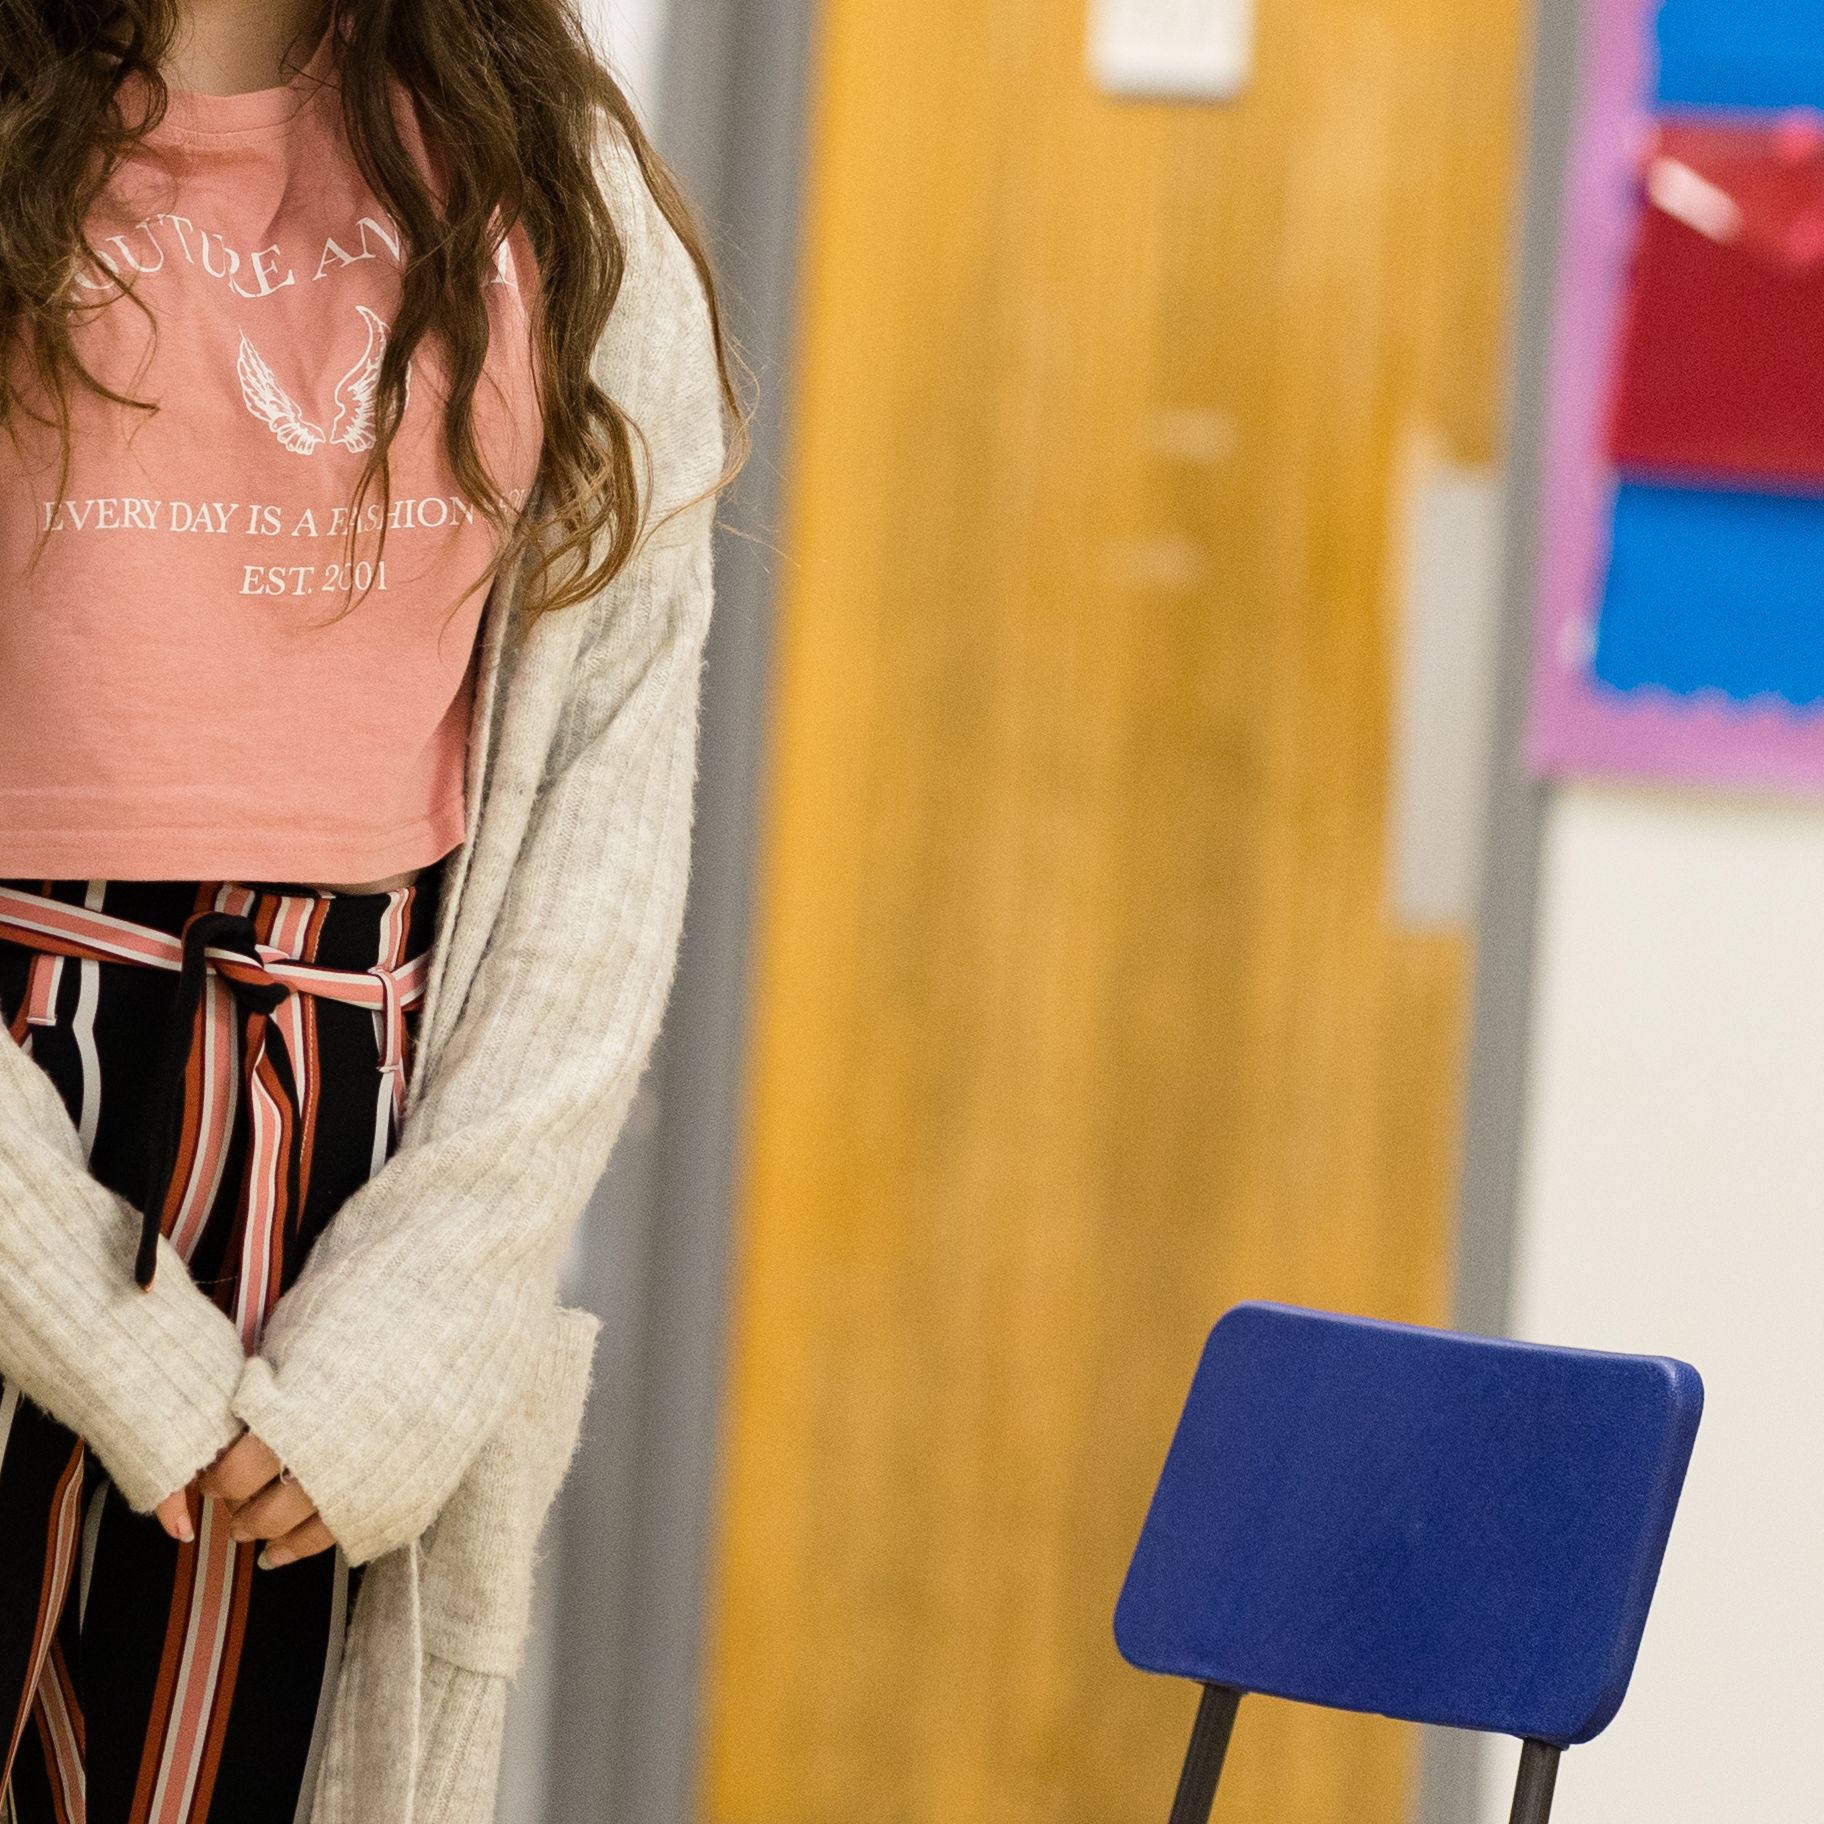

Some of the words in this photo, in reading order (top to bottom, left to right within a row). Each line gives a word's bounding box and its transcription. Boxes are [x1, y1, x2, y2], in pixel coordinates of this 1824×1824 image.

[67, 213, 296, 306] OUTURE
[43, 497, 162, 531] EVERY
[169, 501, 239, 533] DAY
[245, 504, 282, 537] IS
[290, 507, 319, 538] A
[327, 496, 474, 537] FASHION
[239, 565, 312, 597] EST.
[321, 560, 388, 592] 2001
